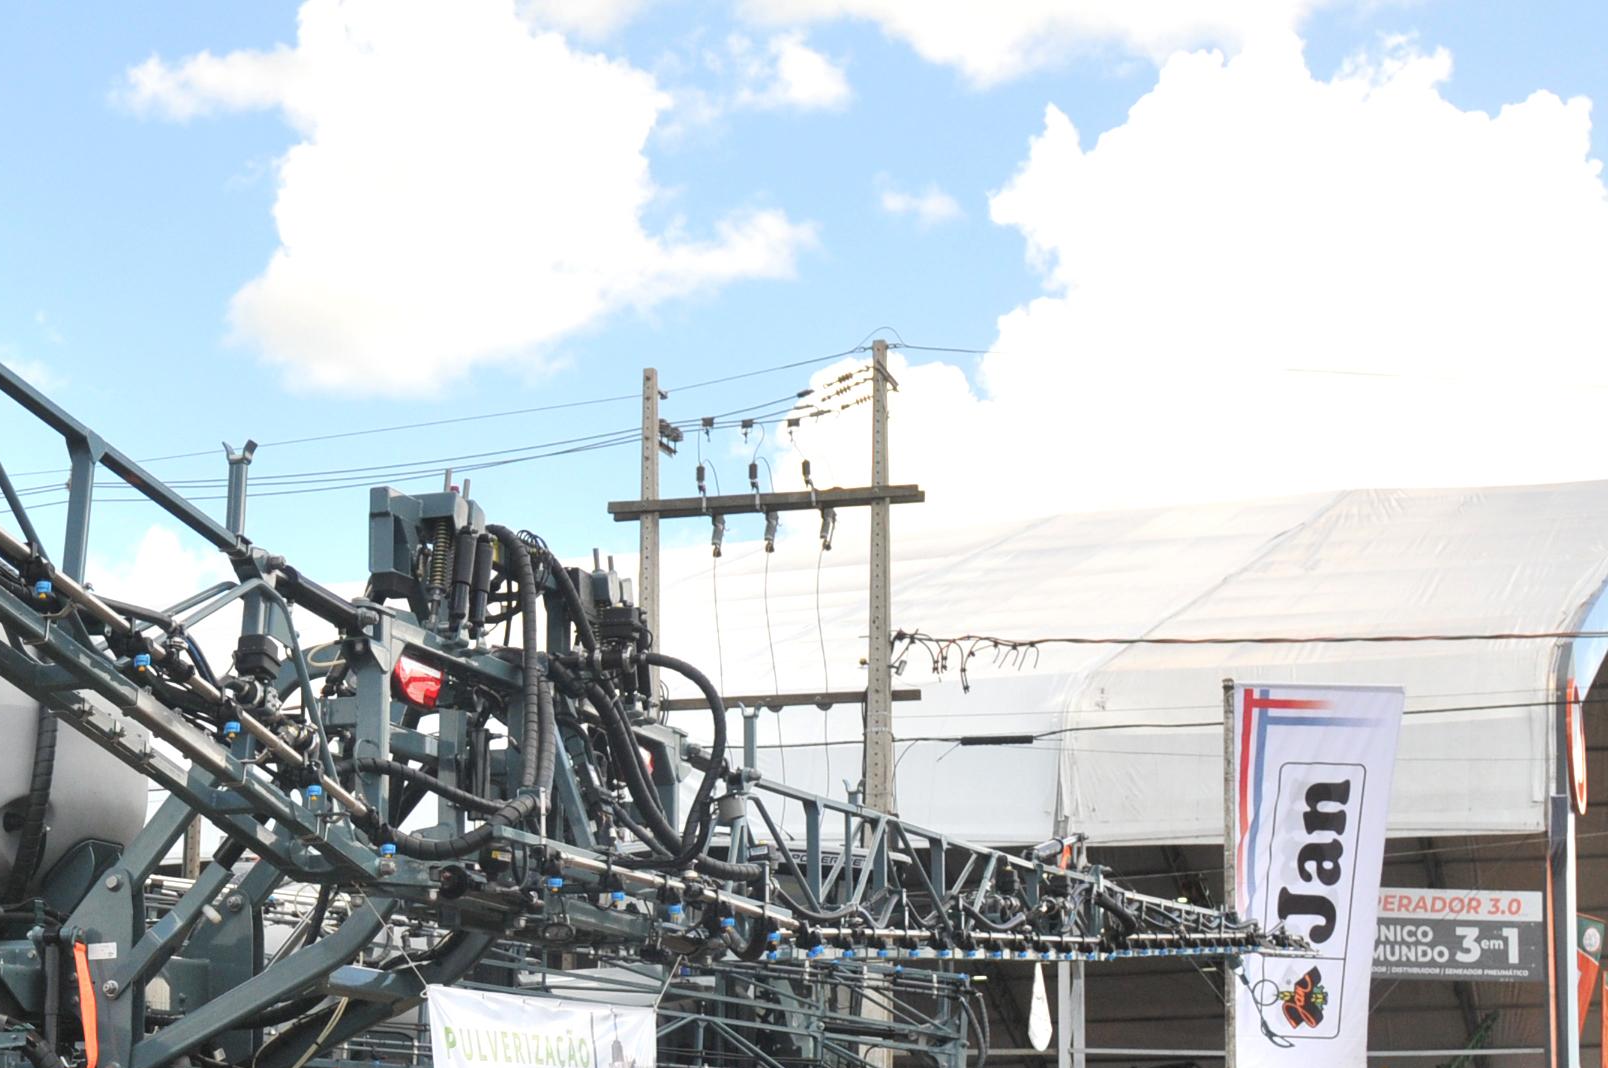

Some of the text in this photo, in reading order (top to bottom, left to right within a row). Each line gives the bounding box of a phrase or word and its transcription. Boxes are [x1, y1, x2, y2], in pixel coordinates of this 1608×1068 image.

[1276, 779, 1351, 944] Jan
[1377, 895, 1522, 916] ERADOR 3.0
[1455, 927, 1481, 963] 3
[1502, 927, 1519, 964] 1
[1445, 968, 1483, 976] SEMEADOR
